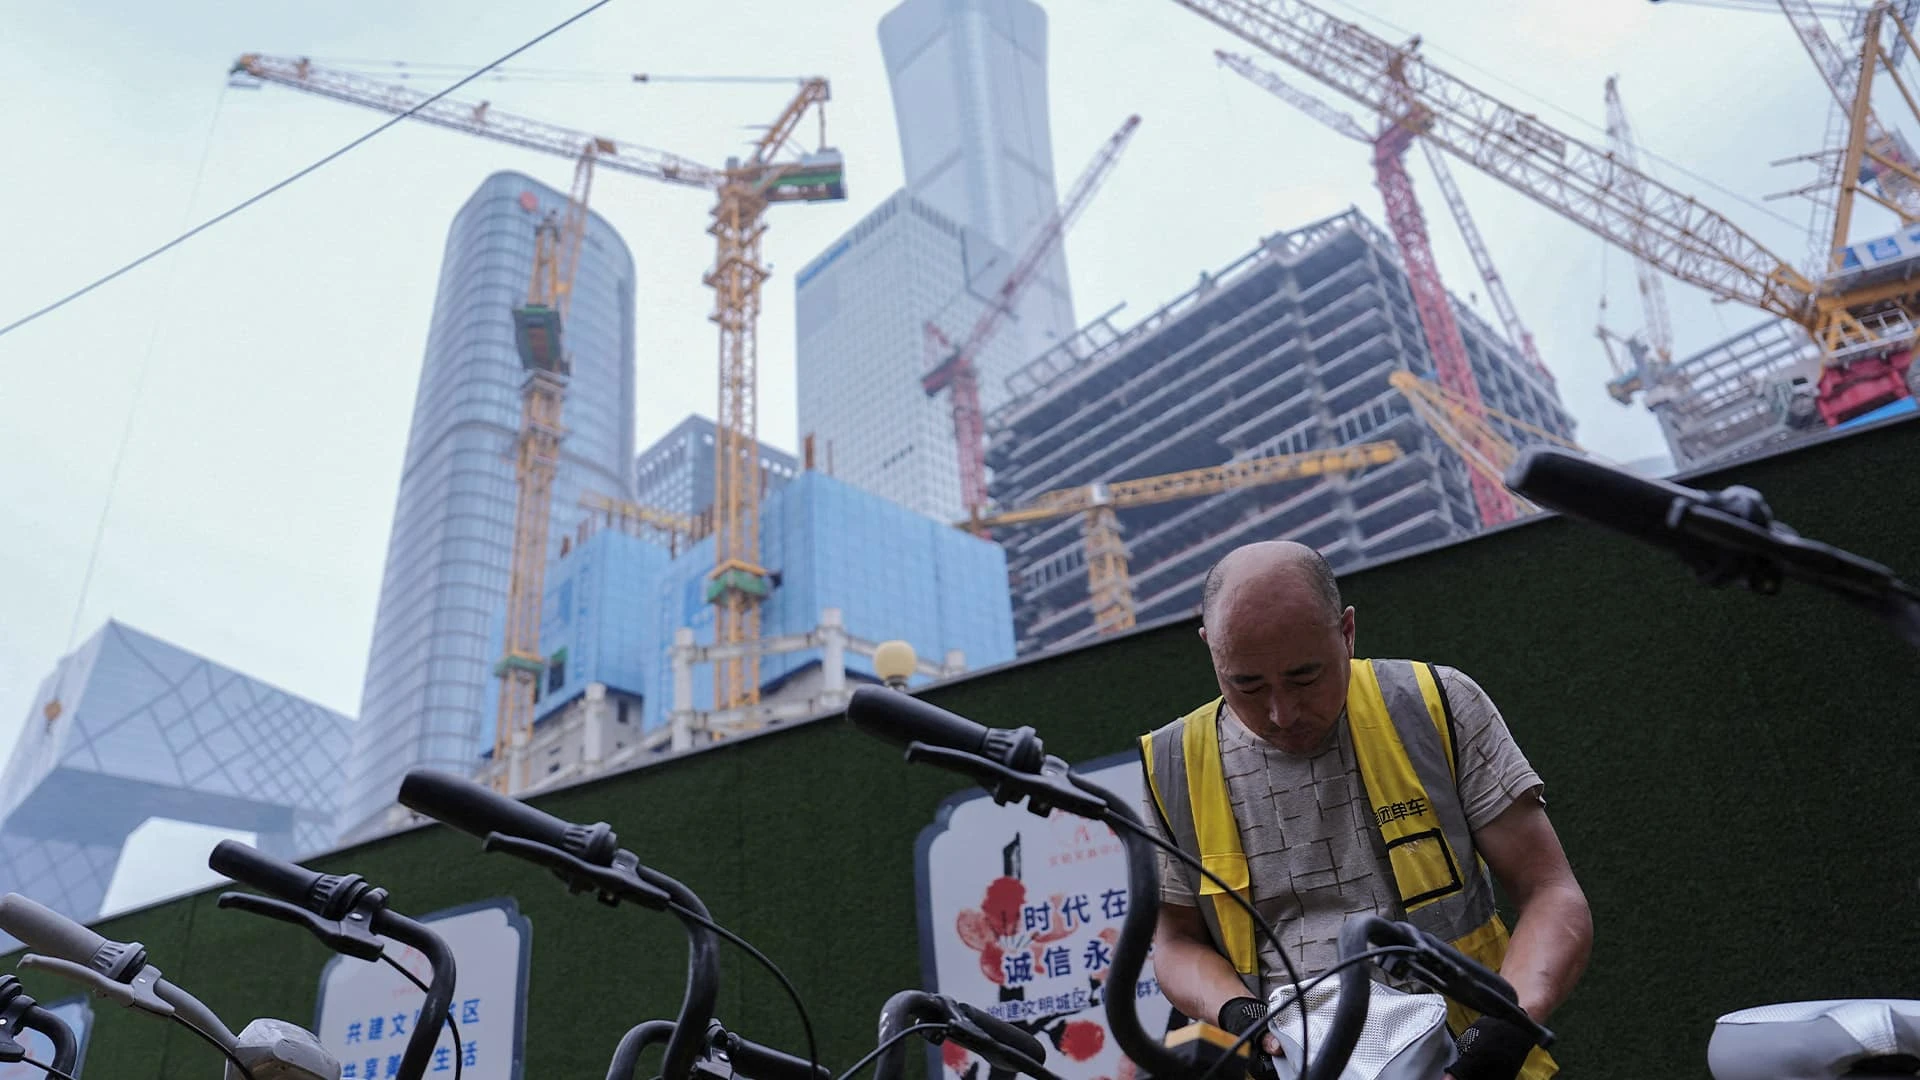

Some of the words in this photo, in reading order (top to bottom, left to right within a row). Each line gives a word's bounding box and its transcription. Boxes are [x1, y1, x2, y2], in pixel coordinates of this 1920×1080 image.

[1376, 797, 1428, 827] 团单车
[1004, 940, 1152, 984] 诚信永
[346, 998, 480, 1045] 共建文区
[343, 1041, 477, 1080] 共享美生活
